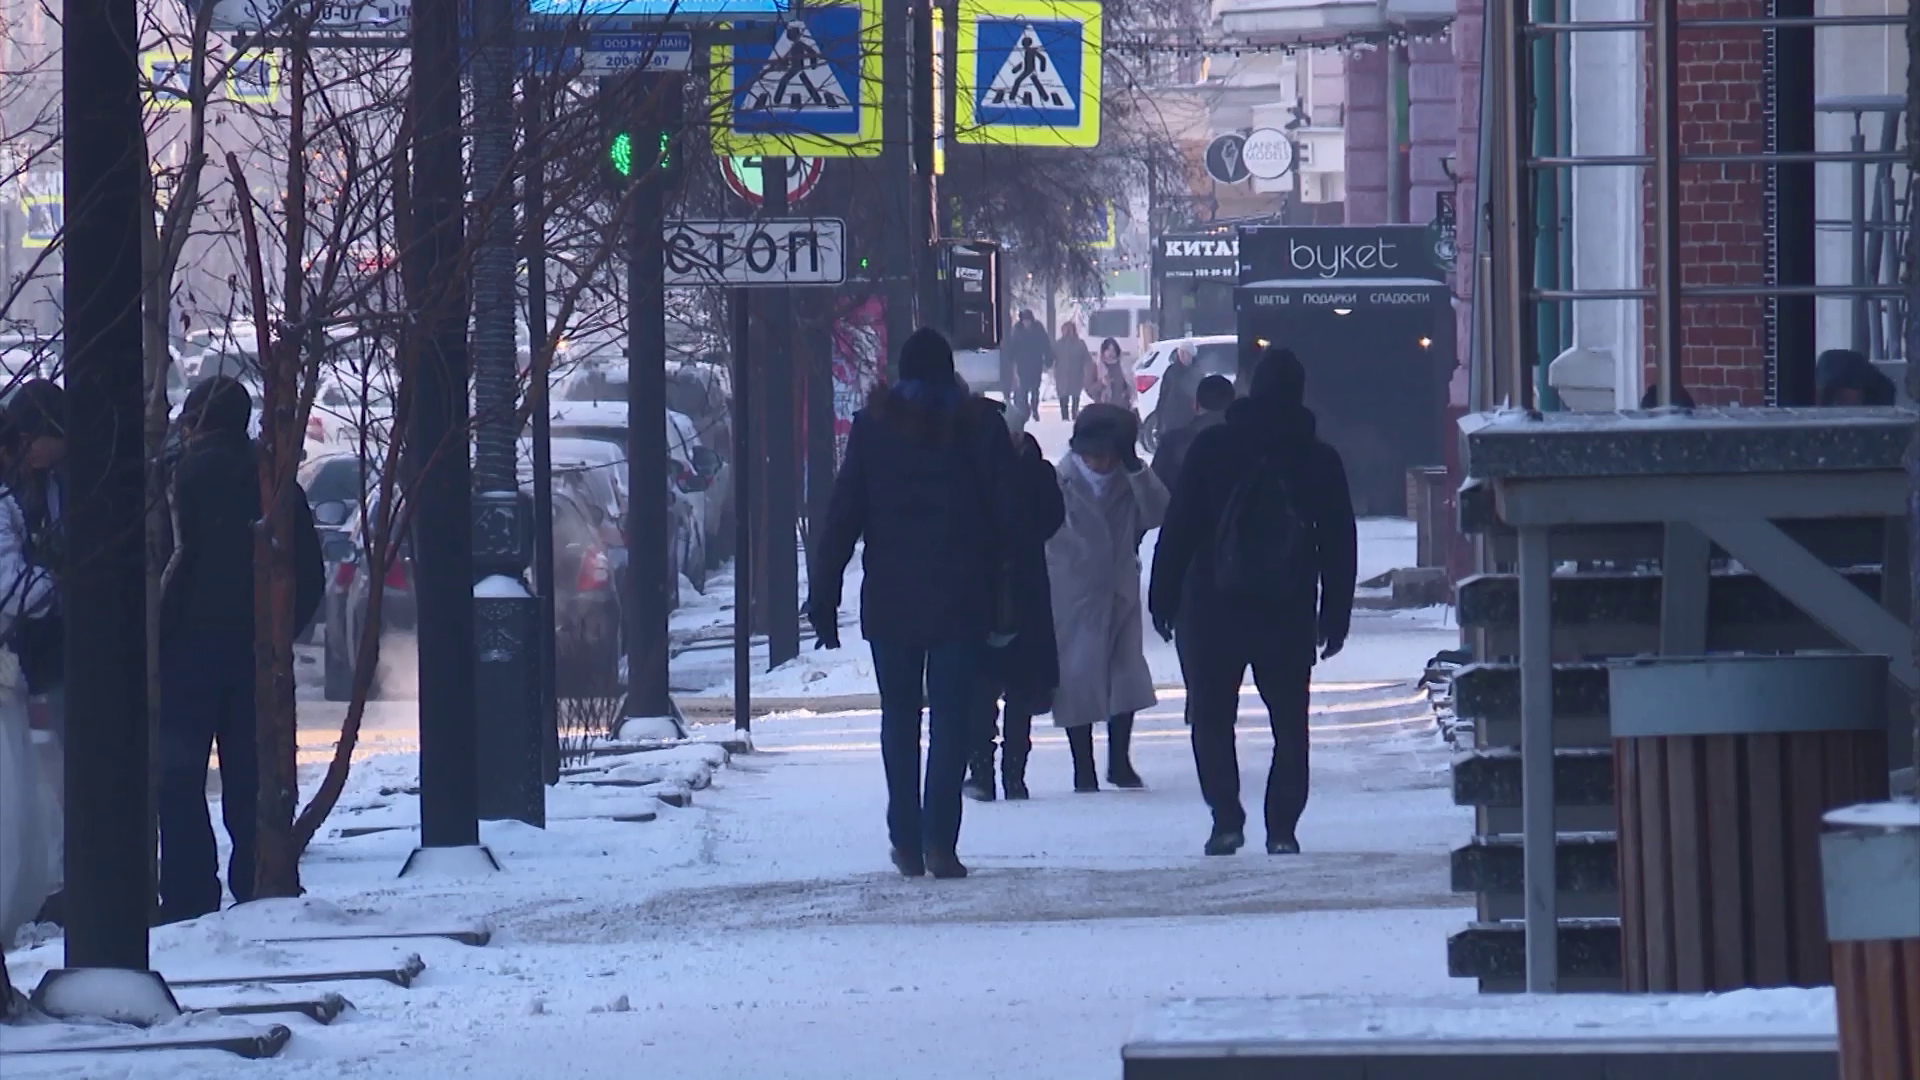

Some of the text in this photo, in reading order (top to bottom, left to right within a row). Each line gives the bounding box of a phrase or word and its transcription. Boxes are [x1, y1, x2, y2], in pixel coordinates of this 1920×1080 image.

[603, 39, 628, 48] ООО
[1246, 151, 1289, 160] MODELS
[667, 230, 818, 274] СТОП
[1254, 293, 1430, 305] ЦВЕТЫ ПОДАРКИ СЛАДОСТИ
